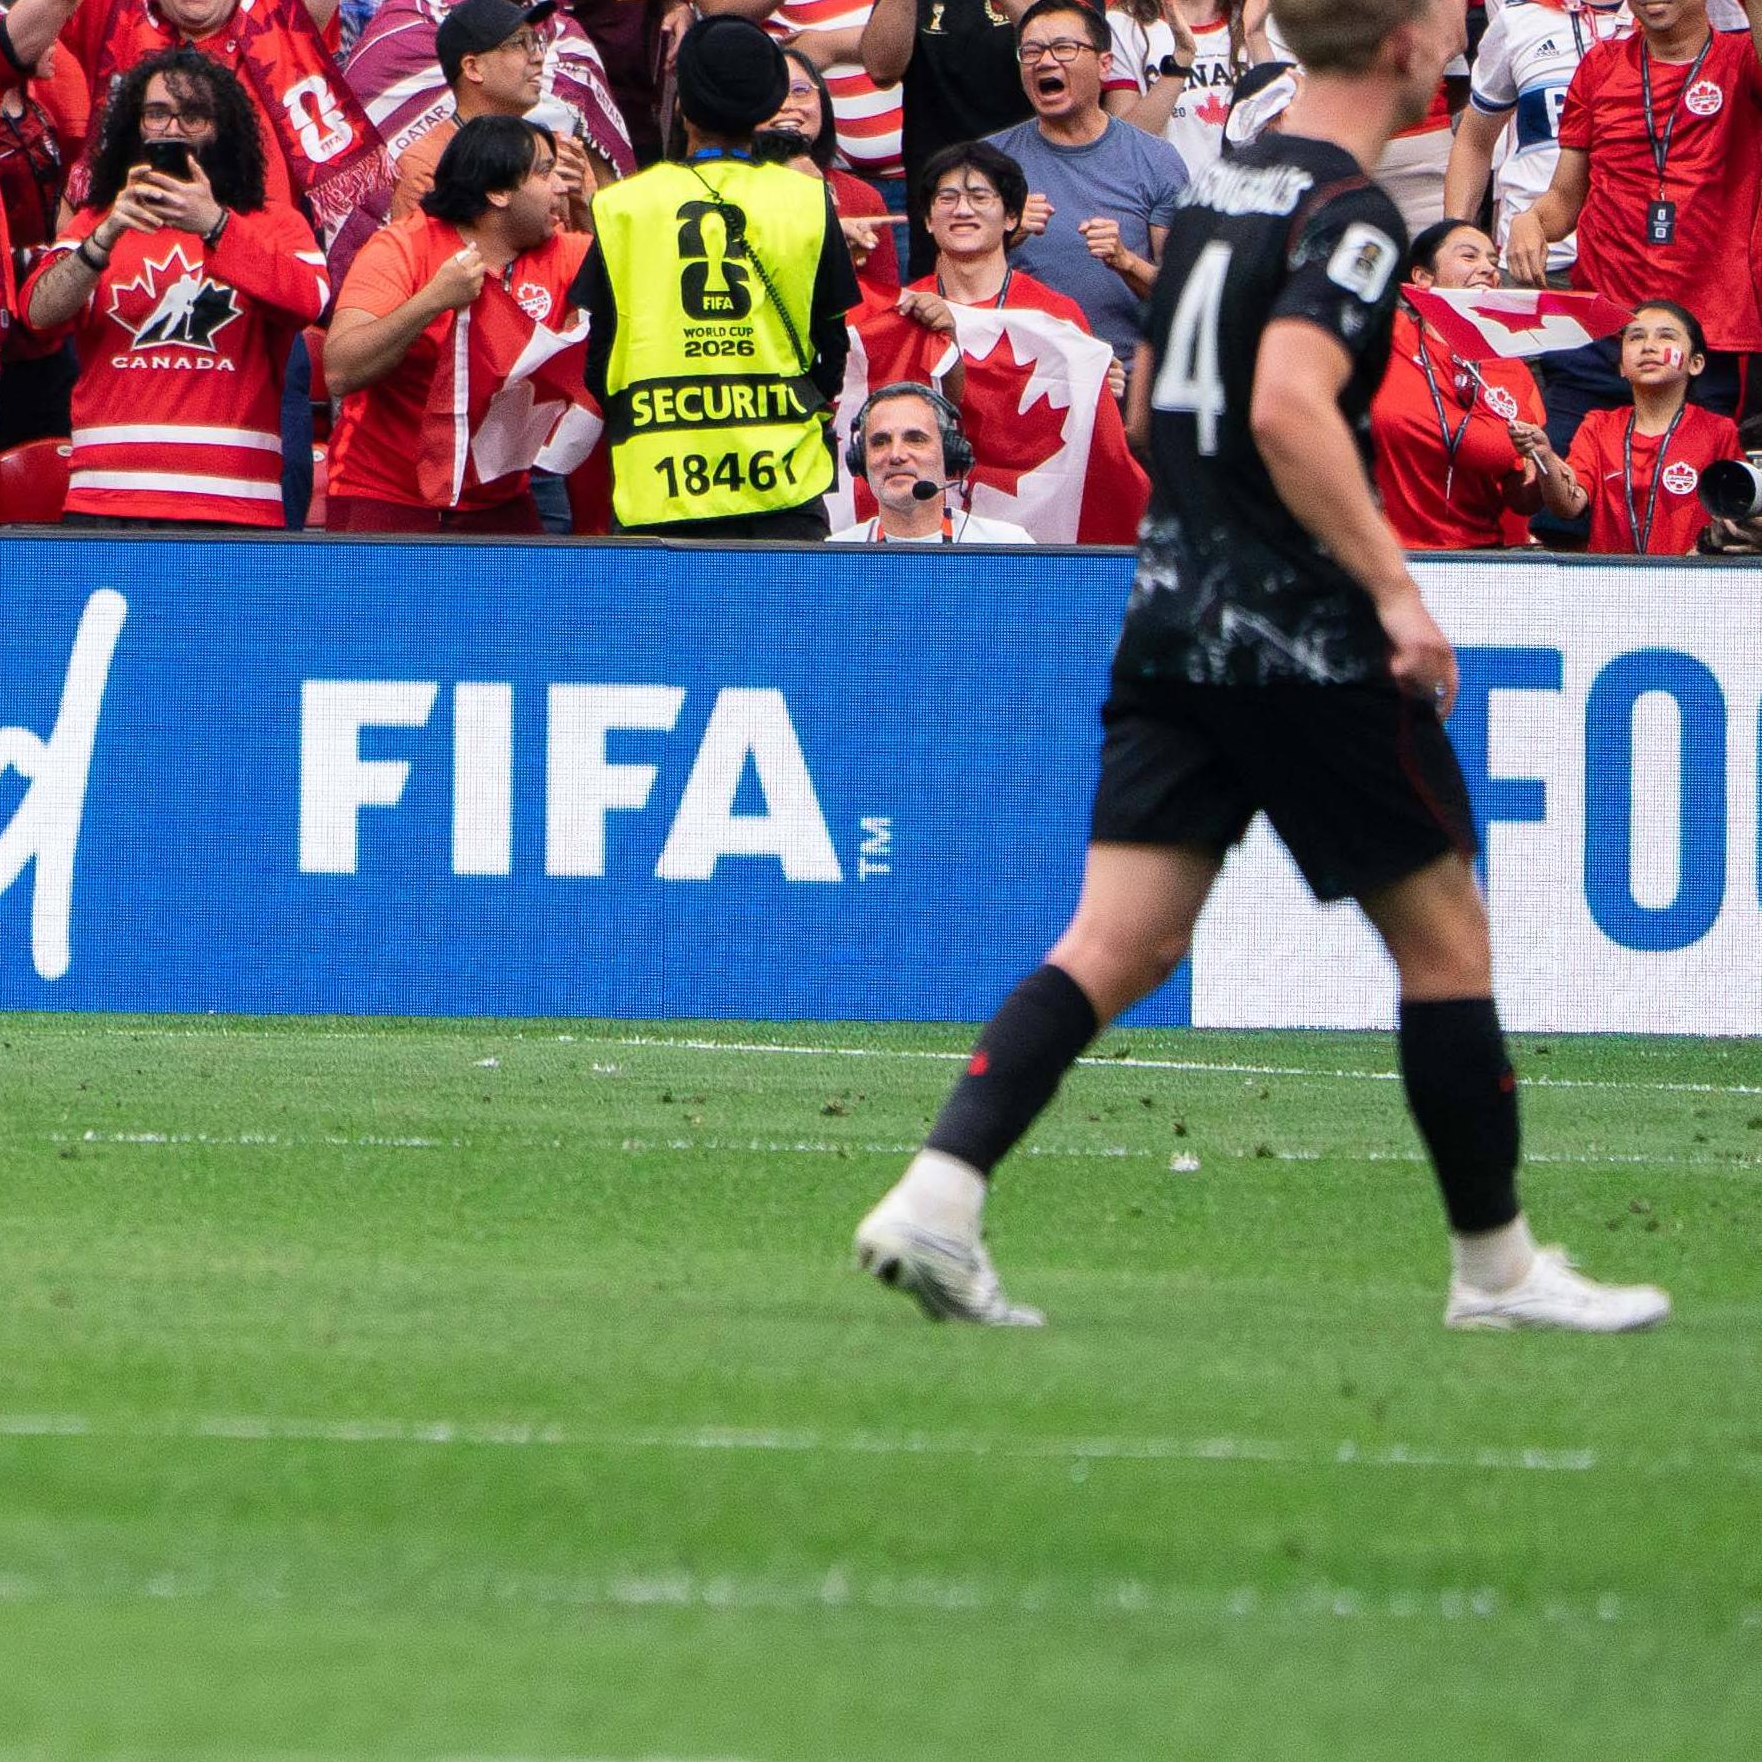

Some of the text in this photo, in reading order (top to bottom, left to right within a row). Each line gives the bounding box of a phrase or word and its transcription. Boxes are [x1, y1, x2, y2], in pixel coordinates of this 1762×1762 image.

[395, 110, 445, 152] QATAR
[702, 297, 734, 312] FIFA
[683, 326, 754, 339] WORLD CUP
[683, 339, 755, 358] 2026
[1151, 241, 1231, 457] 4
[112, 356, 235, 371] CANADA
[299, 683, 843, 888] FIFA
